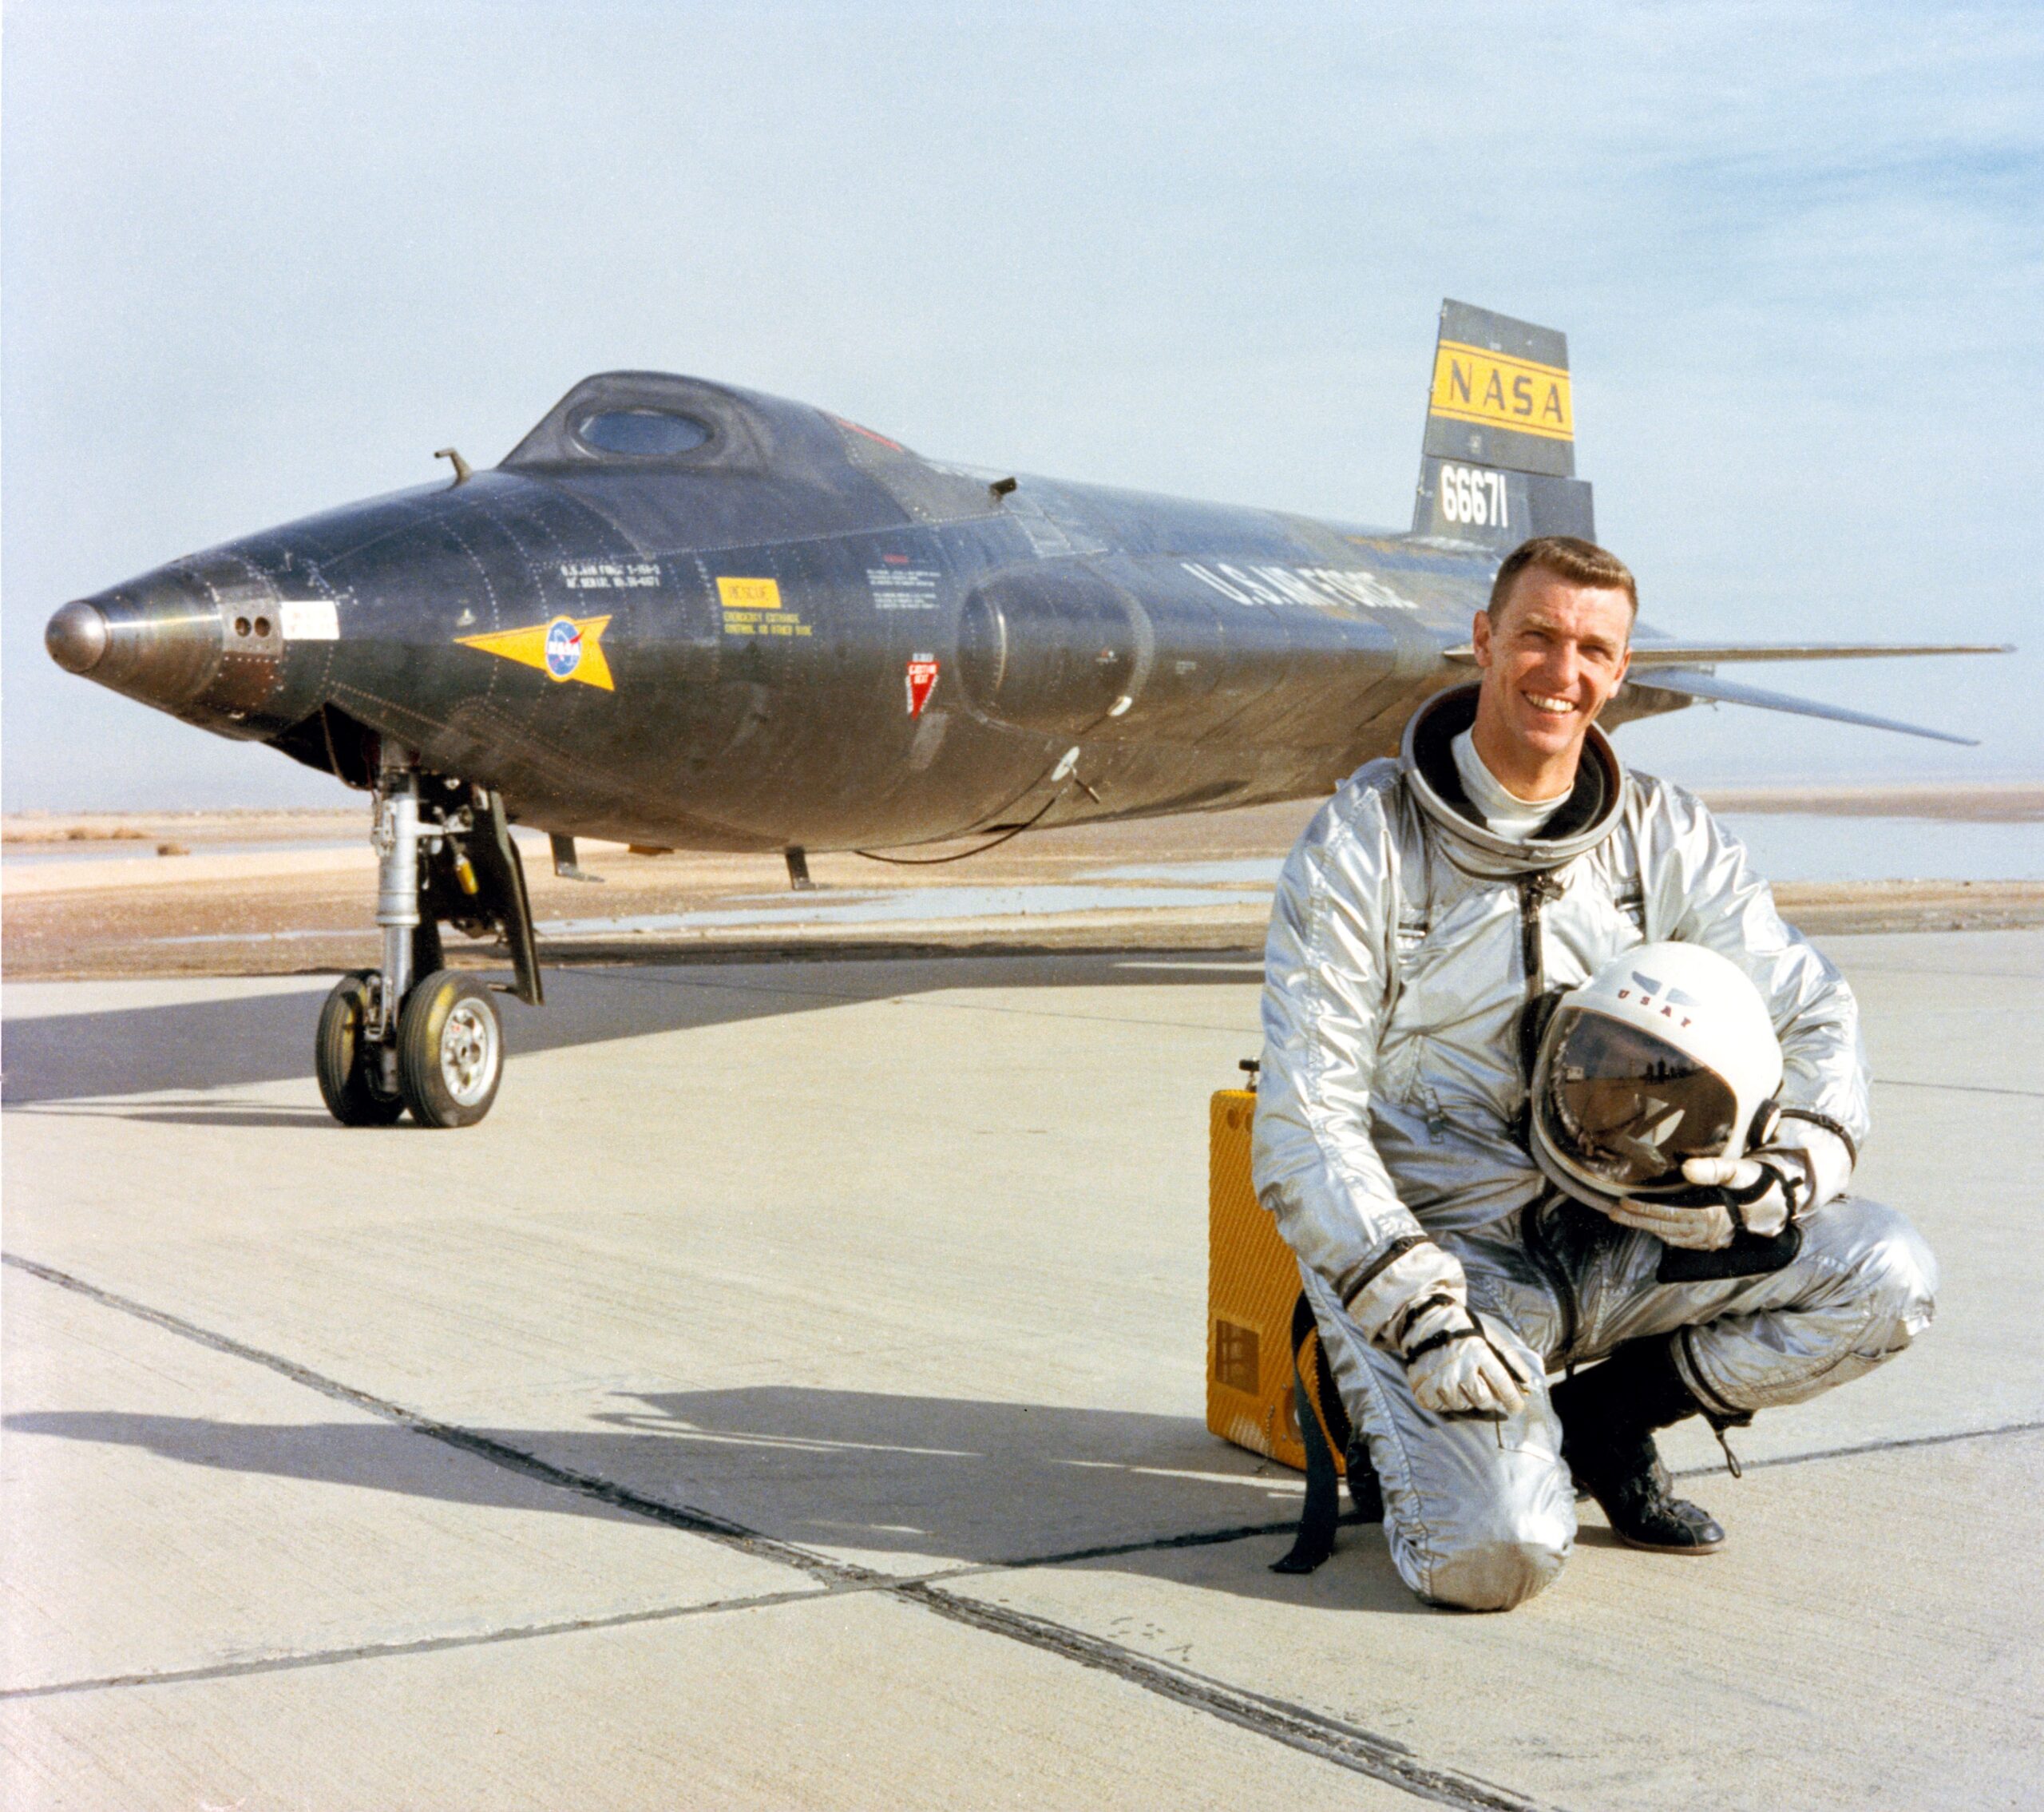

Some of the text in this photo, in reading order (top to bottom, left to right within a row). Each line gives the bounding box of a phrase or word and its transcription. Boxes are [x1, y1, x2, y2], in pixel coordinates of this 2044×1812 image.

[1450, 359, 1563, 423] NASA
[1441, 465, 1507, 528] 66671
[1180, 562, 1293, 606] U.S.
[1248, 565, 1339, 606] AIR
[549, 641, 580, 655] NASA
[1618, 989, 1692, 1028] USAF
